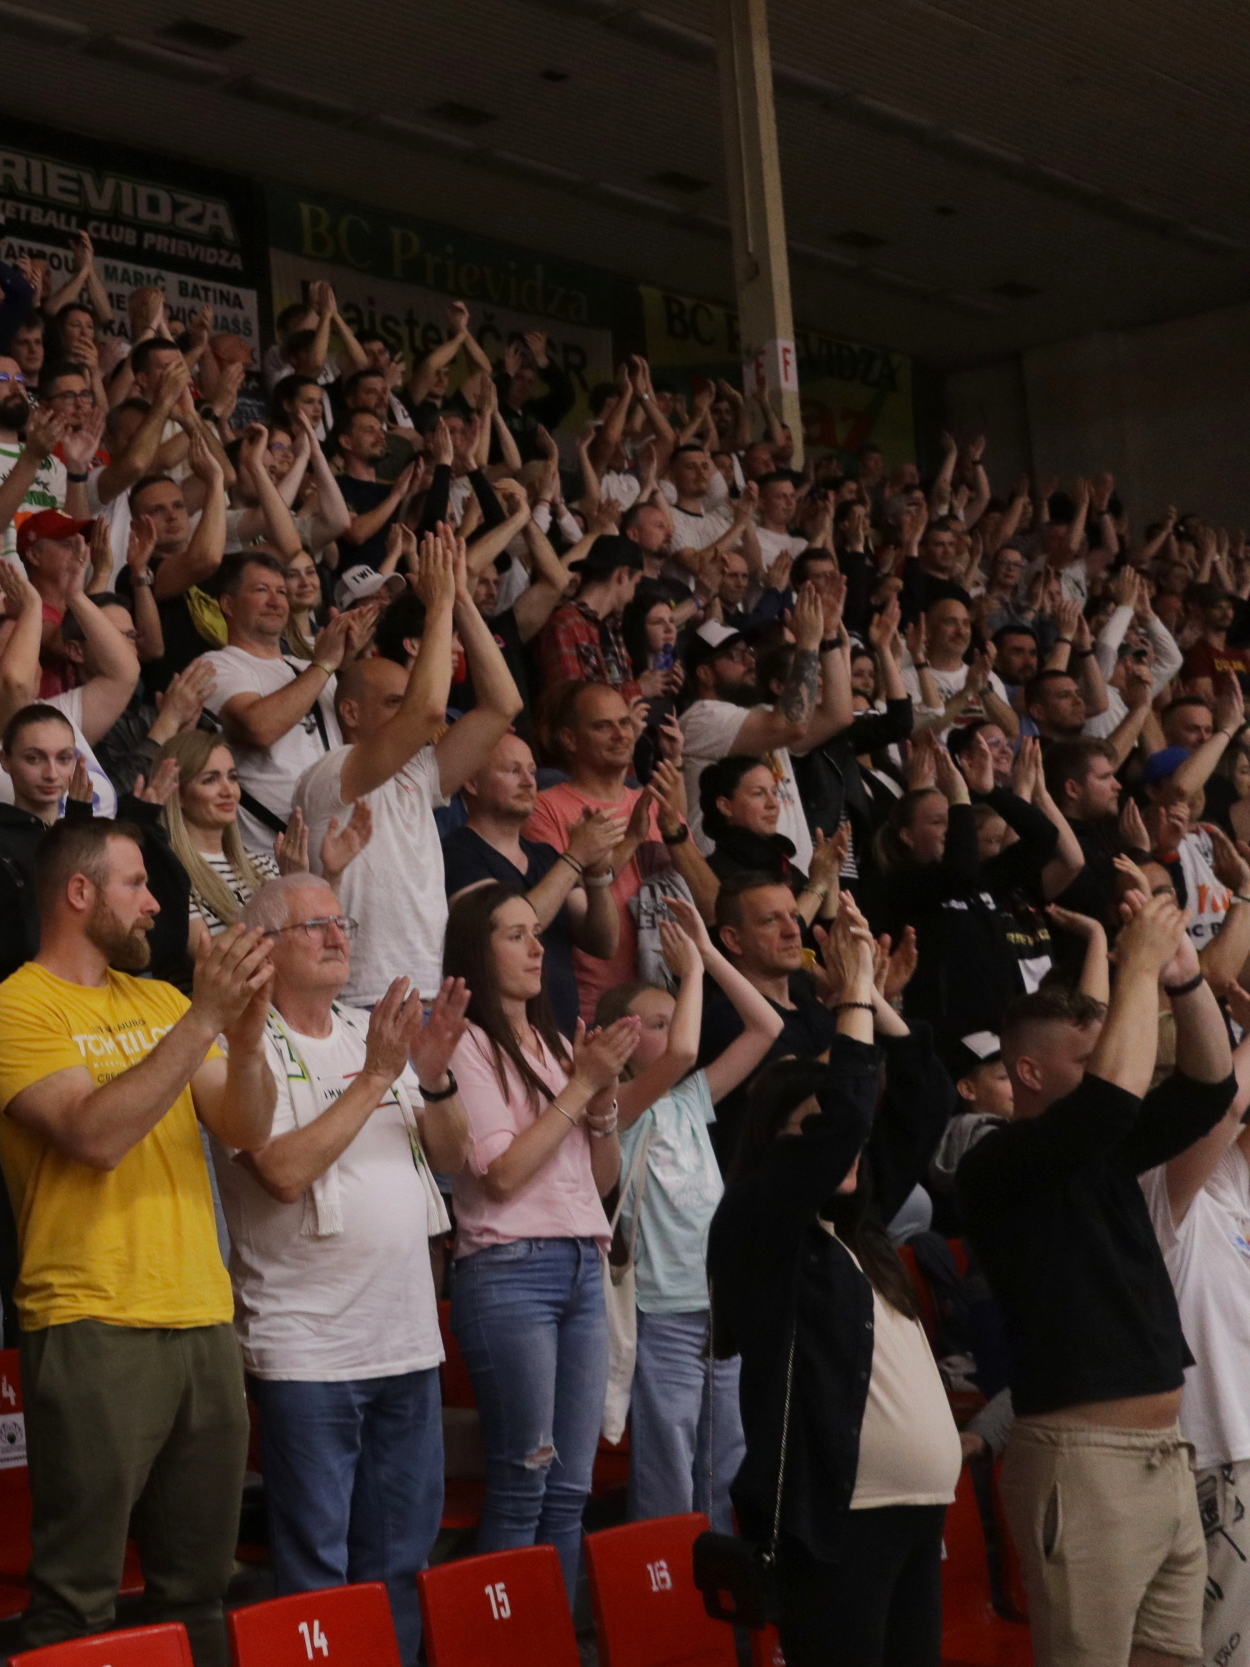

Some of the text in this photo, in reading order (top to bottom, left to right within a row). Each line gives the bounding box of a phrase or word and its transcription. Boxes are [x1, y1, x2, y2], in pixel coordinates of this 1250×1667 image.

[85, 221, 138, 246] CLUB
[142, 231, 244, 272] PRIEVIDZA
[299, 202, 373, 268] BC
[178, 280, 245, 311] BATINA
[781, 346, 792, 382] F
[484, 1581, 512, 1621] 15
[297, 1618, 330, 1661] 14
